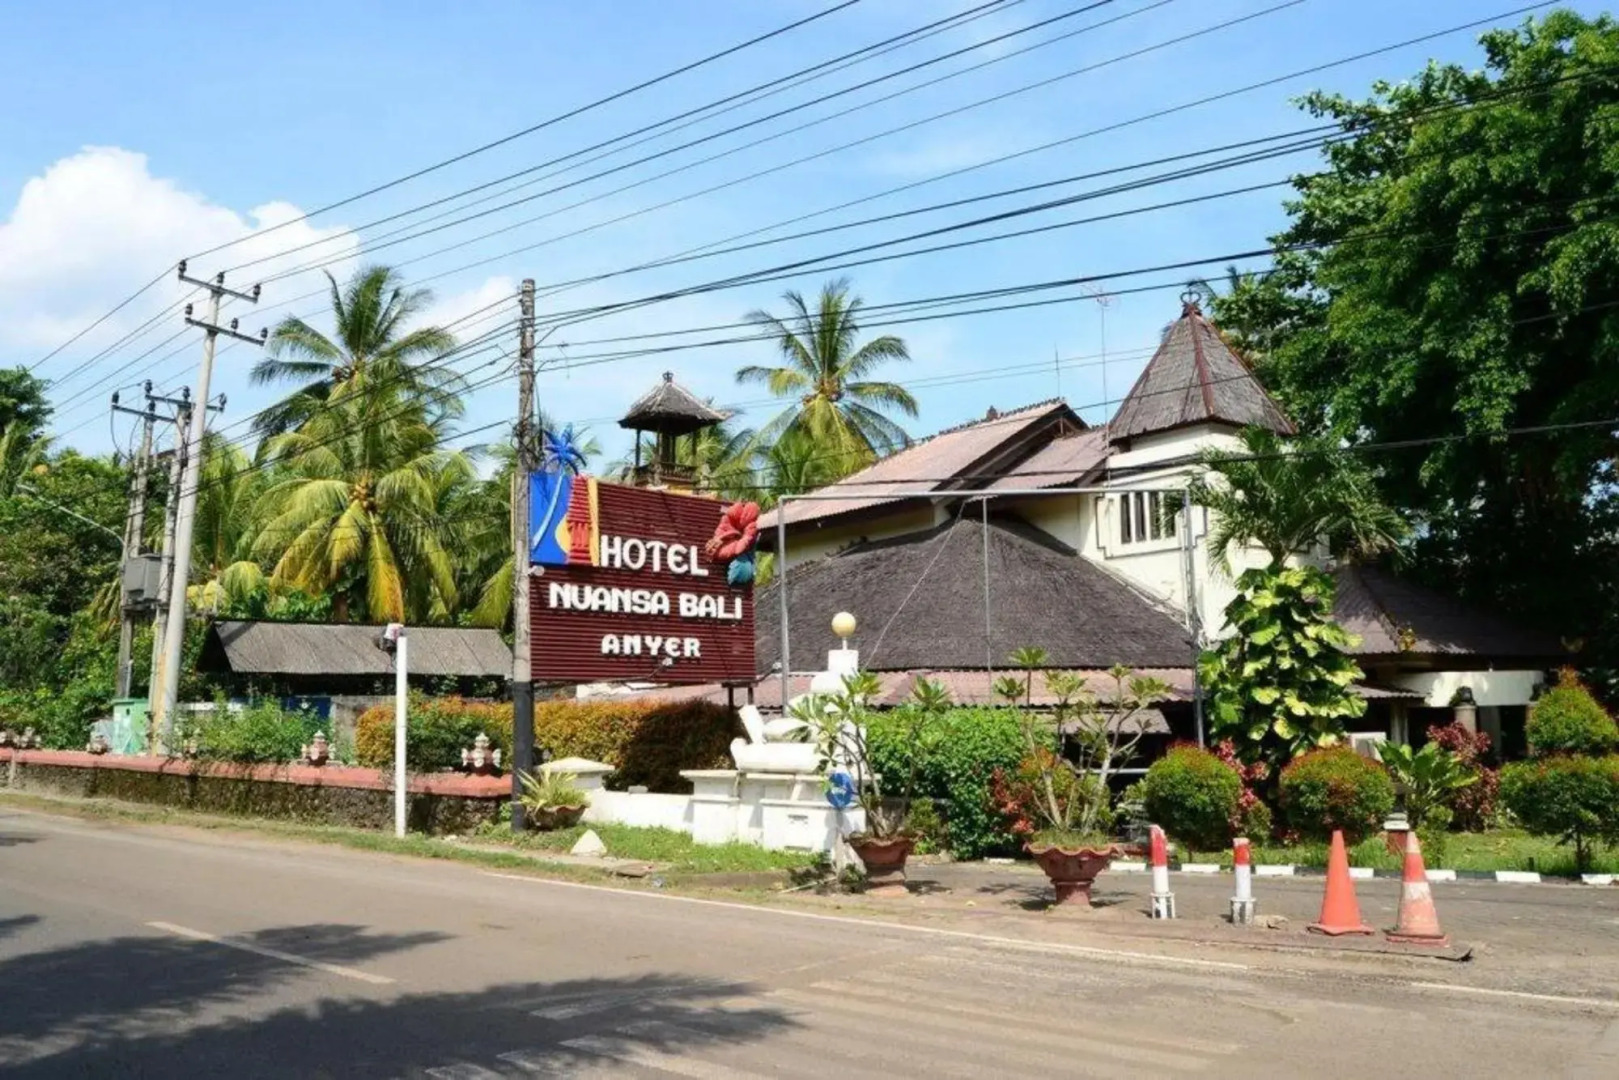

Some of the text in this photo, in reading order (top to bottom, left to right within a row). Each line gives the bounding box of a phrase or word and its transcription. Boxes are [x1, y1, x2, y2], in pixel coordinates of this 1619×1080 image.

[600, 535, 709, 576] HOTEL
[549, 582, 743, 619] NUANSA BALI
[601, 634, 701, 657] ANYER
